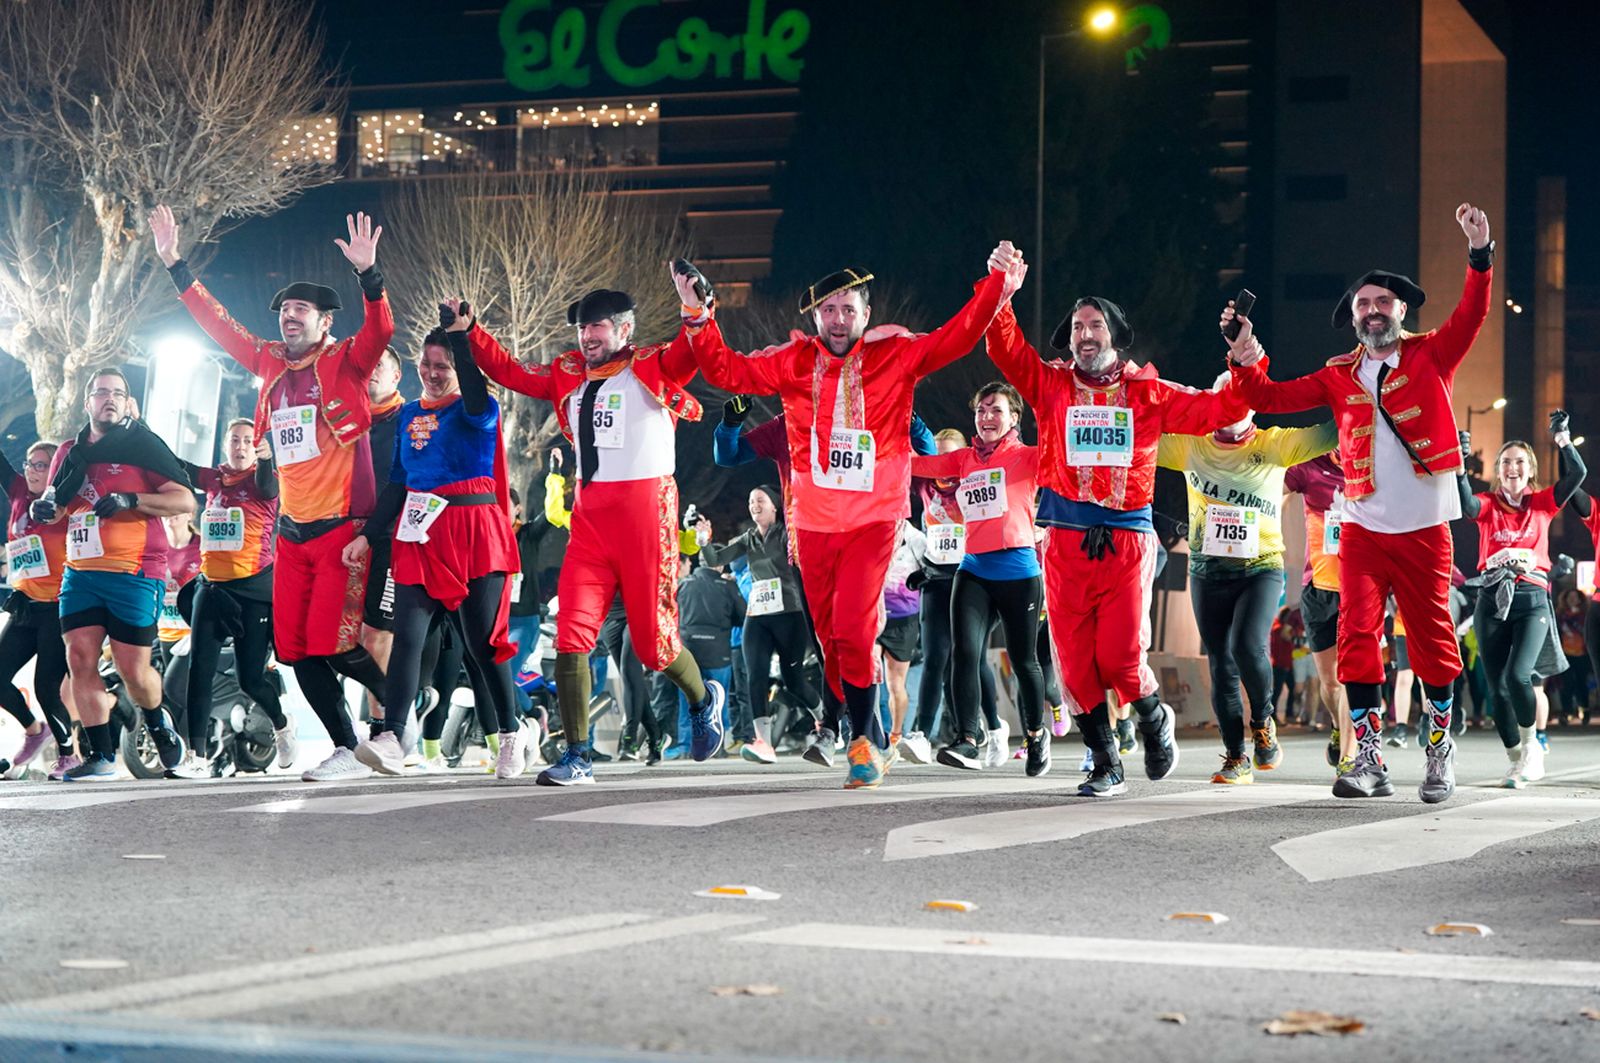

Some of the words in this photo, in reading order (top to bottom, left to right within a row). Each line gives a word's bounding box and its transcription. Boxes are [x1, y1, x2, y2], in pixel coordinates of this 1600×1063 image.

[499, 0, 591, 91] El
[598, 0, 811, 87] Corte
[593, 411, 614, 428] 35
[280, 427, 303, 446] 883
[1073, 427, 1126, 446] 14035
[830, 450, 863, 470] 964
[965, 486, 997, 505] 2889
[1203, 481, 1219, 498] LA
[1226, 489, 1276, 518] PANDERA
[71, 528, 89, 543] 447
[208, 522, 236, 536] 9393
[1215, 523, 1247, 541] 7135
